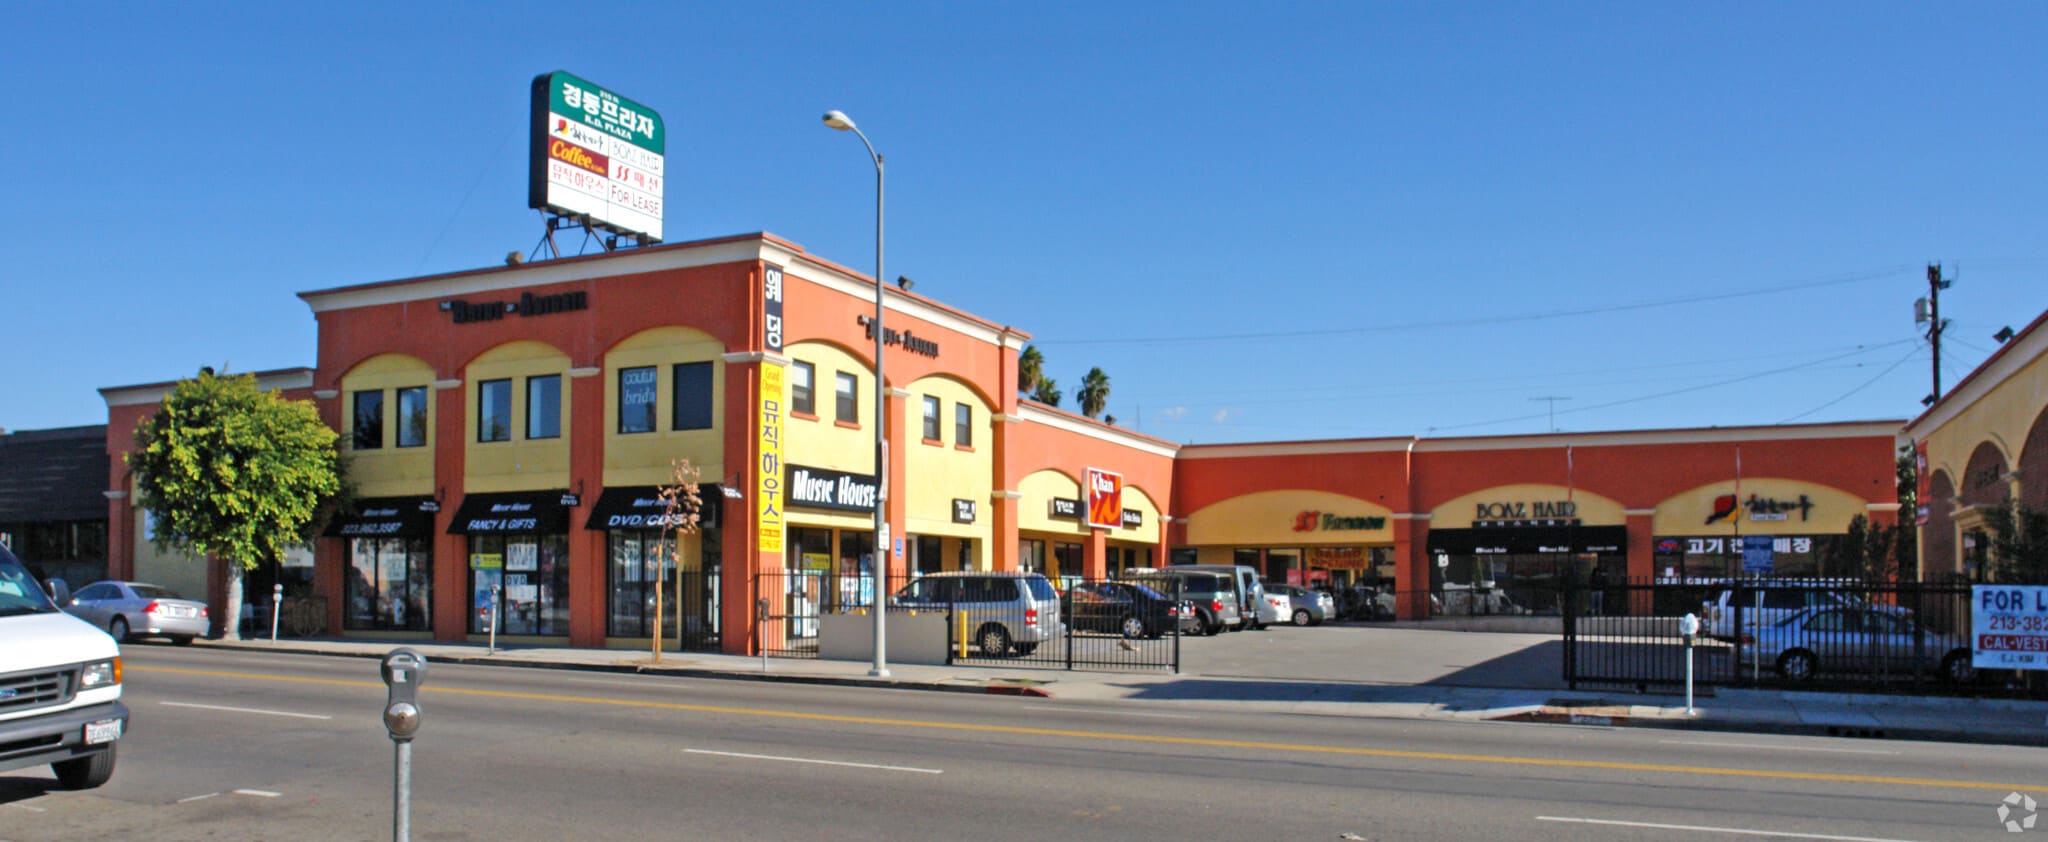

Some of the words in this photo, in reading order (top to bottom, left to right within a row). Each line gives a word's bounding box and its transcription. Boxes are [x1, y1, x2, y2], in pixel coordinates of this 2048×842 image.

[562, 82, 655, 139] 경동프라자
[604, 122, 632, 141] PLAZA
[551, 140, 593, 169] Coffee
[553, 164, 605, 194] 뮤직하우스
[611, 184, 630, 205] FOR
[632, 191, 660, 216] LEASE
[765, 269, 782, 348] 웨딩
[762, 399, 780, 525] 뮤직하우스
[1091, 471, 1115, 500] Khan
[467, 519, 498, 530] FANCY
[508, 518, 537, 529] GIFTS
[1476, 503, 1526, 519] BOAZ
[1532, 502, 1576, 518] HAIR
[1687, 538, 1724, 554] 고기
[1982, 590, 2024, 611] FOR
